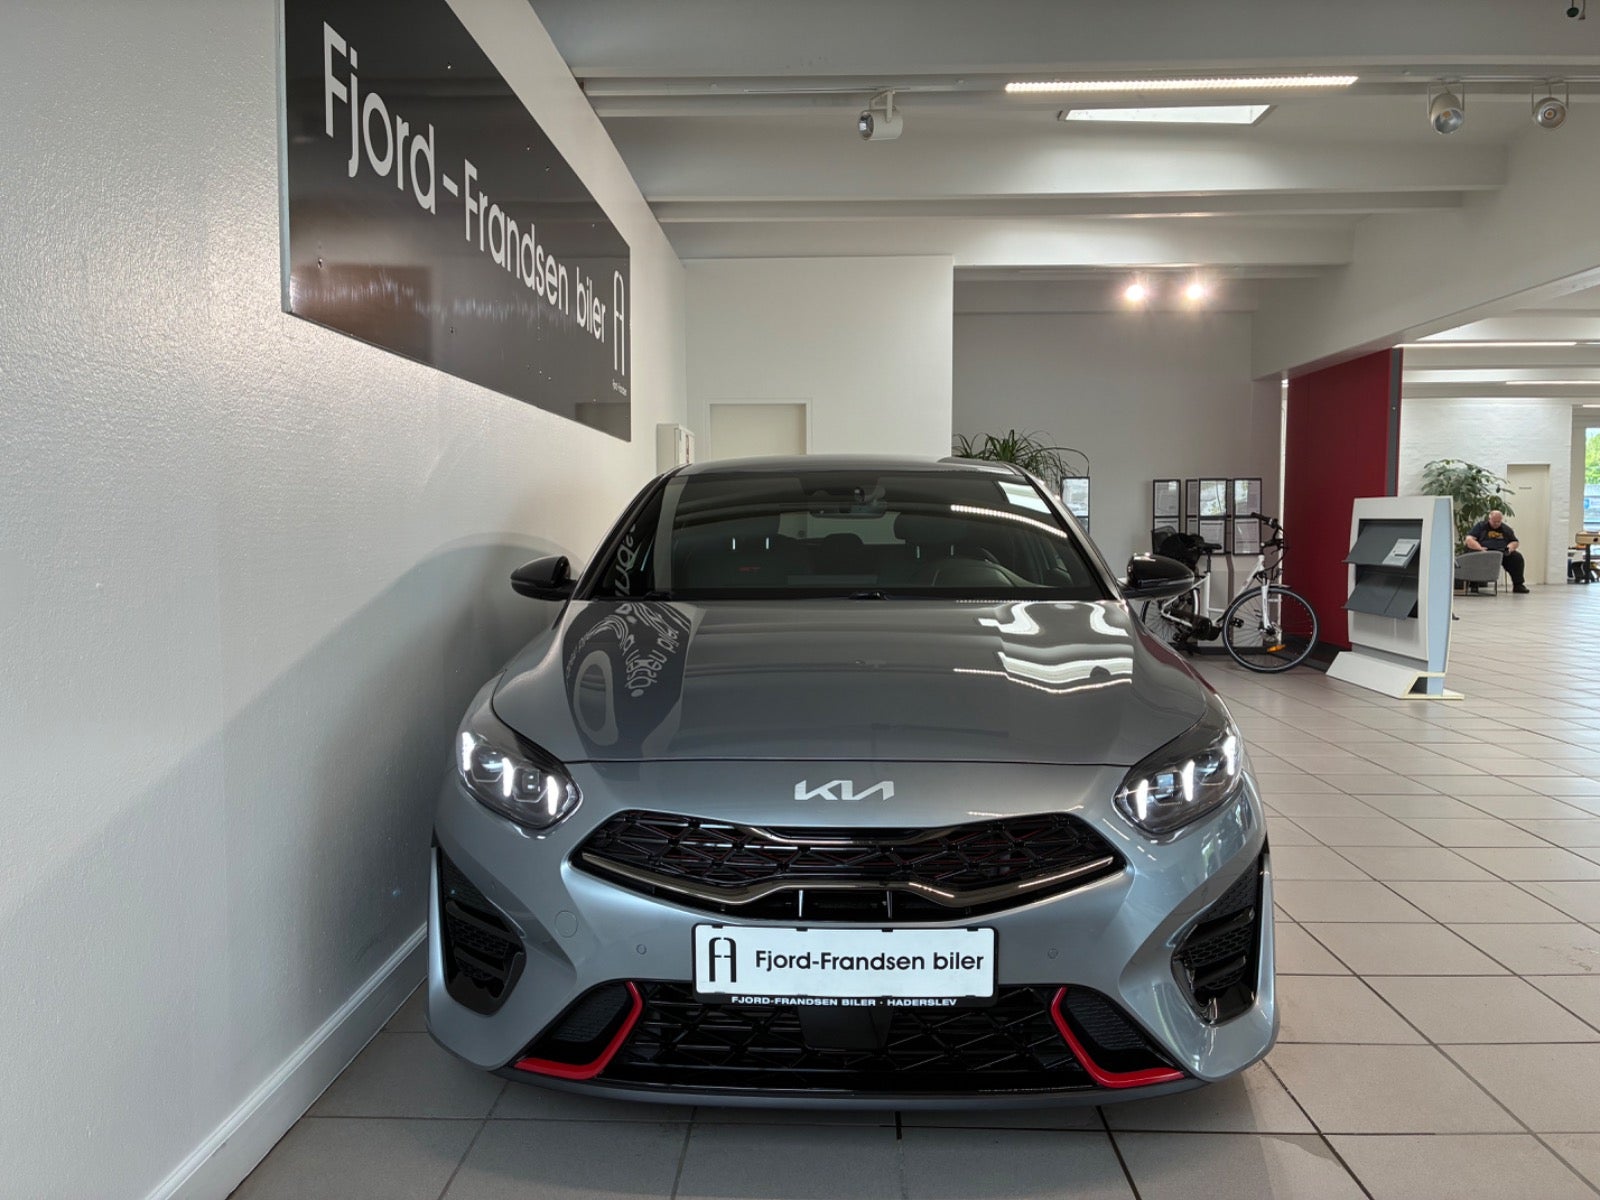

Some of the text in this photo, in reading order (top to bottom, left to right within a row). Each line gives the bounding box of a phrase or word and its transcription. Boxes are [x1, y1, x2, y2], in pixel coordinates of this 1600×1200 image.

[576, 267, 606, 343] biler
[755, 950, 984, 971] Fjord-Frandsen biler
[731, 996, 957, 1007] FJORD-FRANDSEN BILER HADERSLEV
